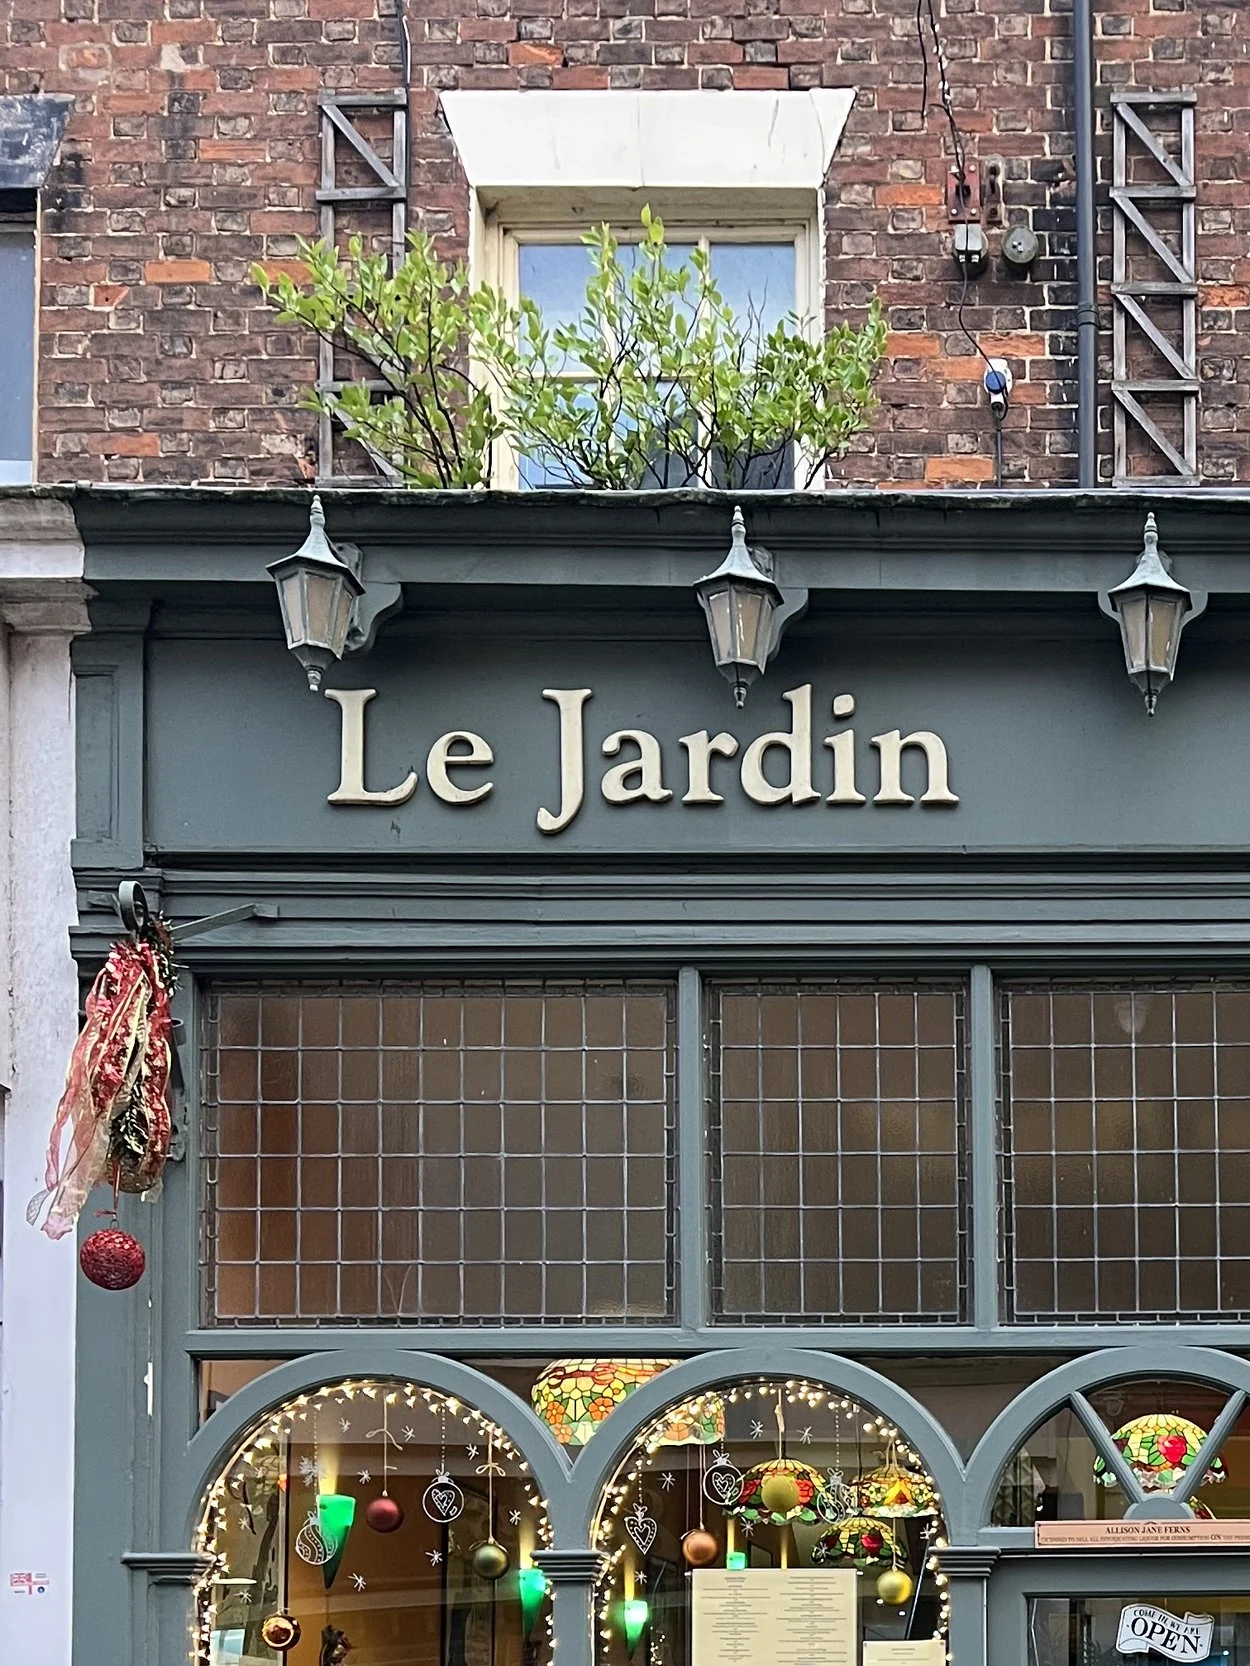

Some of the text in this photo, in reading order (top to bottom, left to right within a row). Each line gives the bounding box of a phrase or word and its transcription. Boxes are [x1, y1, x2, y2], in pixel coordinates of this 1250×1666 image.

[325, 683, 961, 834] Le Jardin
[1106, 1526, 1191, 1534] ALLISON JANE FERNS
[1131, 1616, 1201, 1654] OPEN
[1133, 1609, 1200, 1635] COME IN WE ARE
